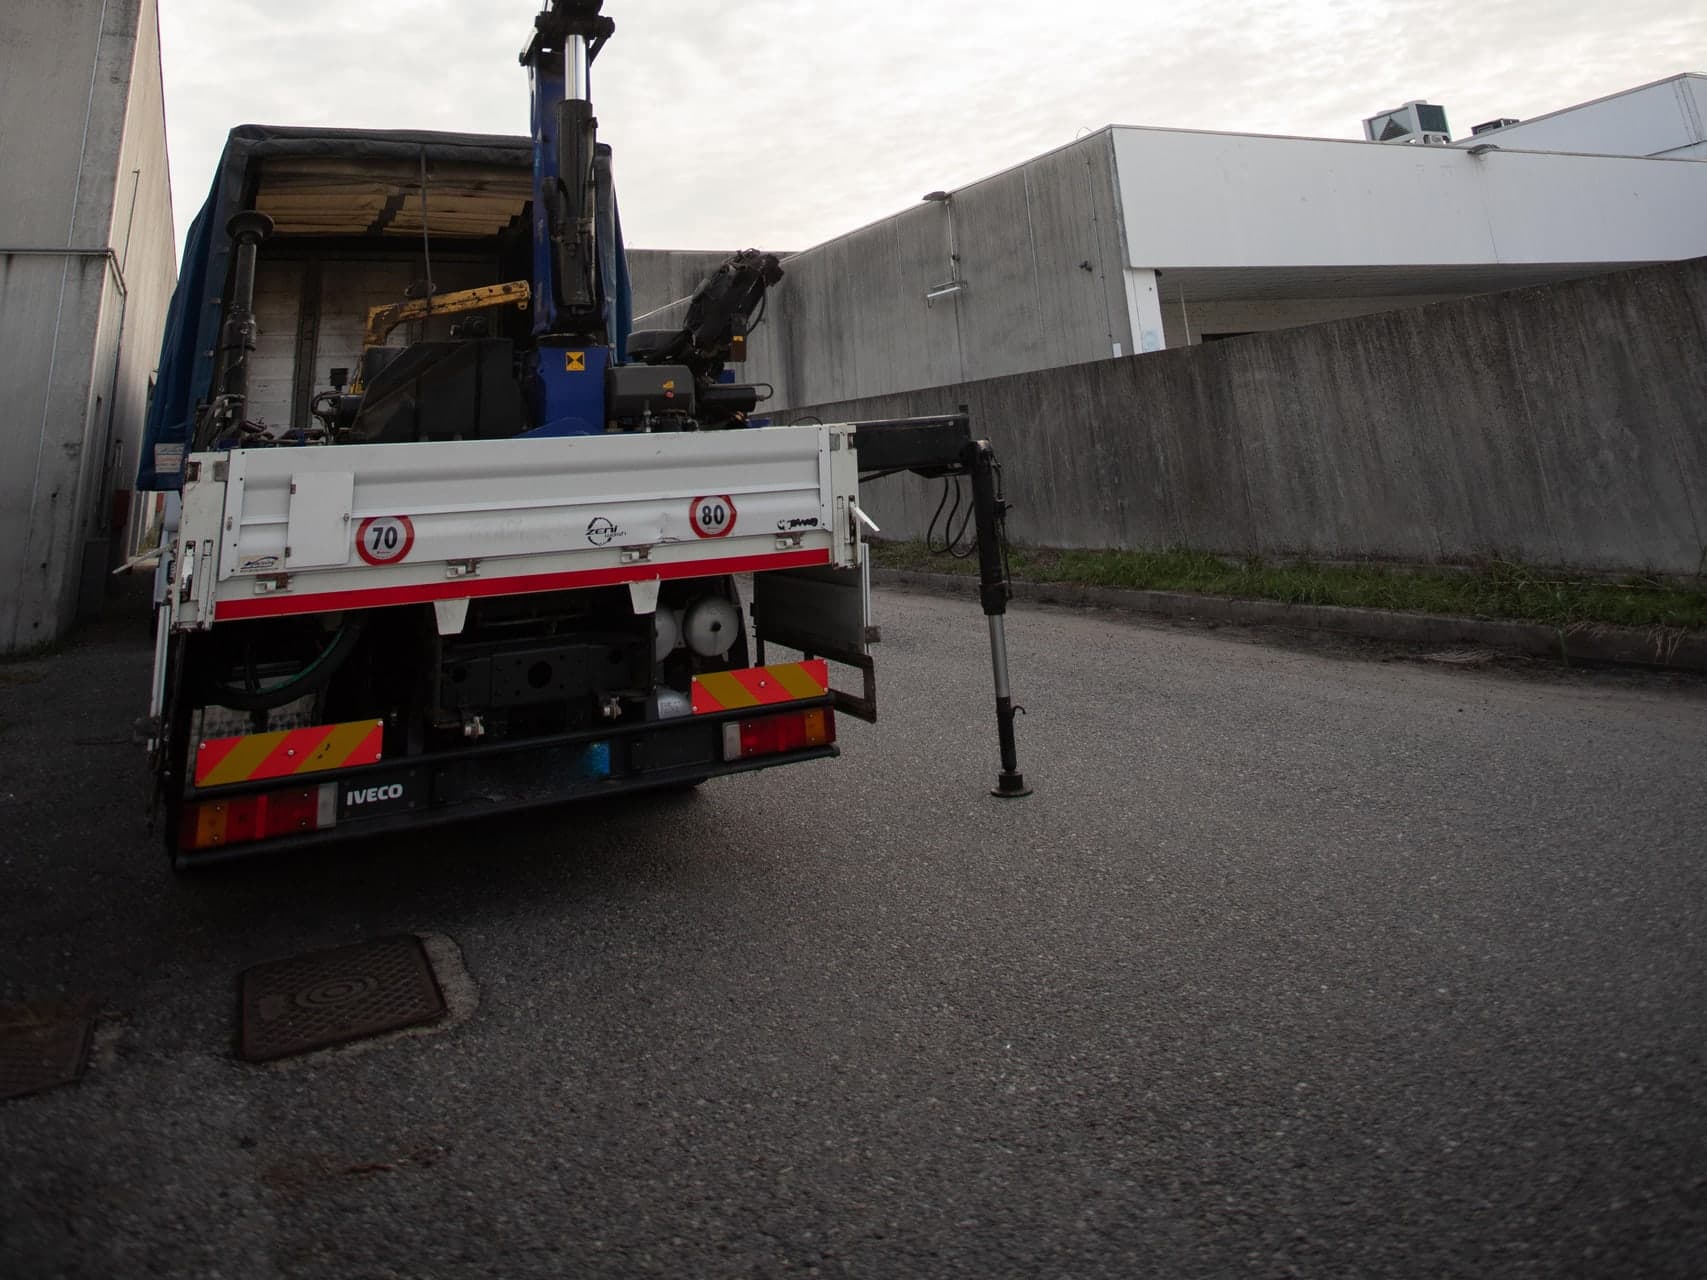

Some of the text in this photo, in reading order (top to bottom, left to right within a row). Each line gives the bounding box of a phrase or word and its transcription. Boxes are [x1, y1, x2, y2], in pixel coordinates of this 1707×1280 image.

[702, 504, 725, 526] 80
[372, 526, 398, 550] 70
[346, 783, 404, 807] IVECO
